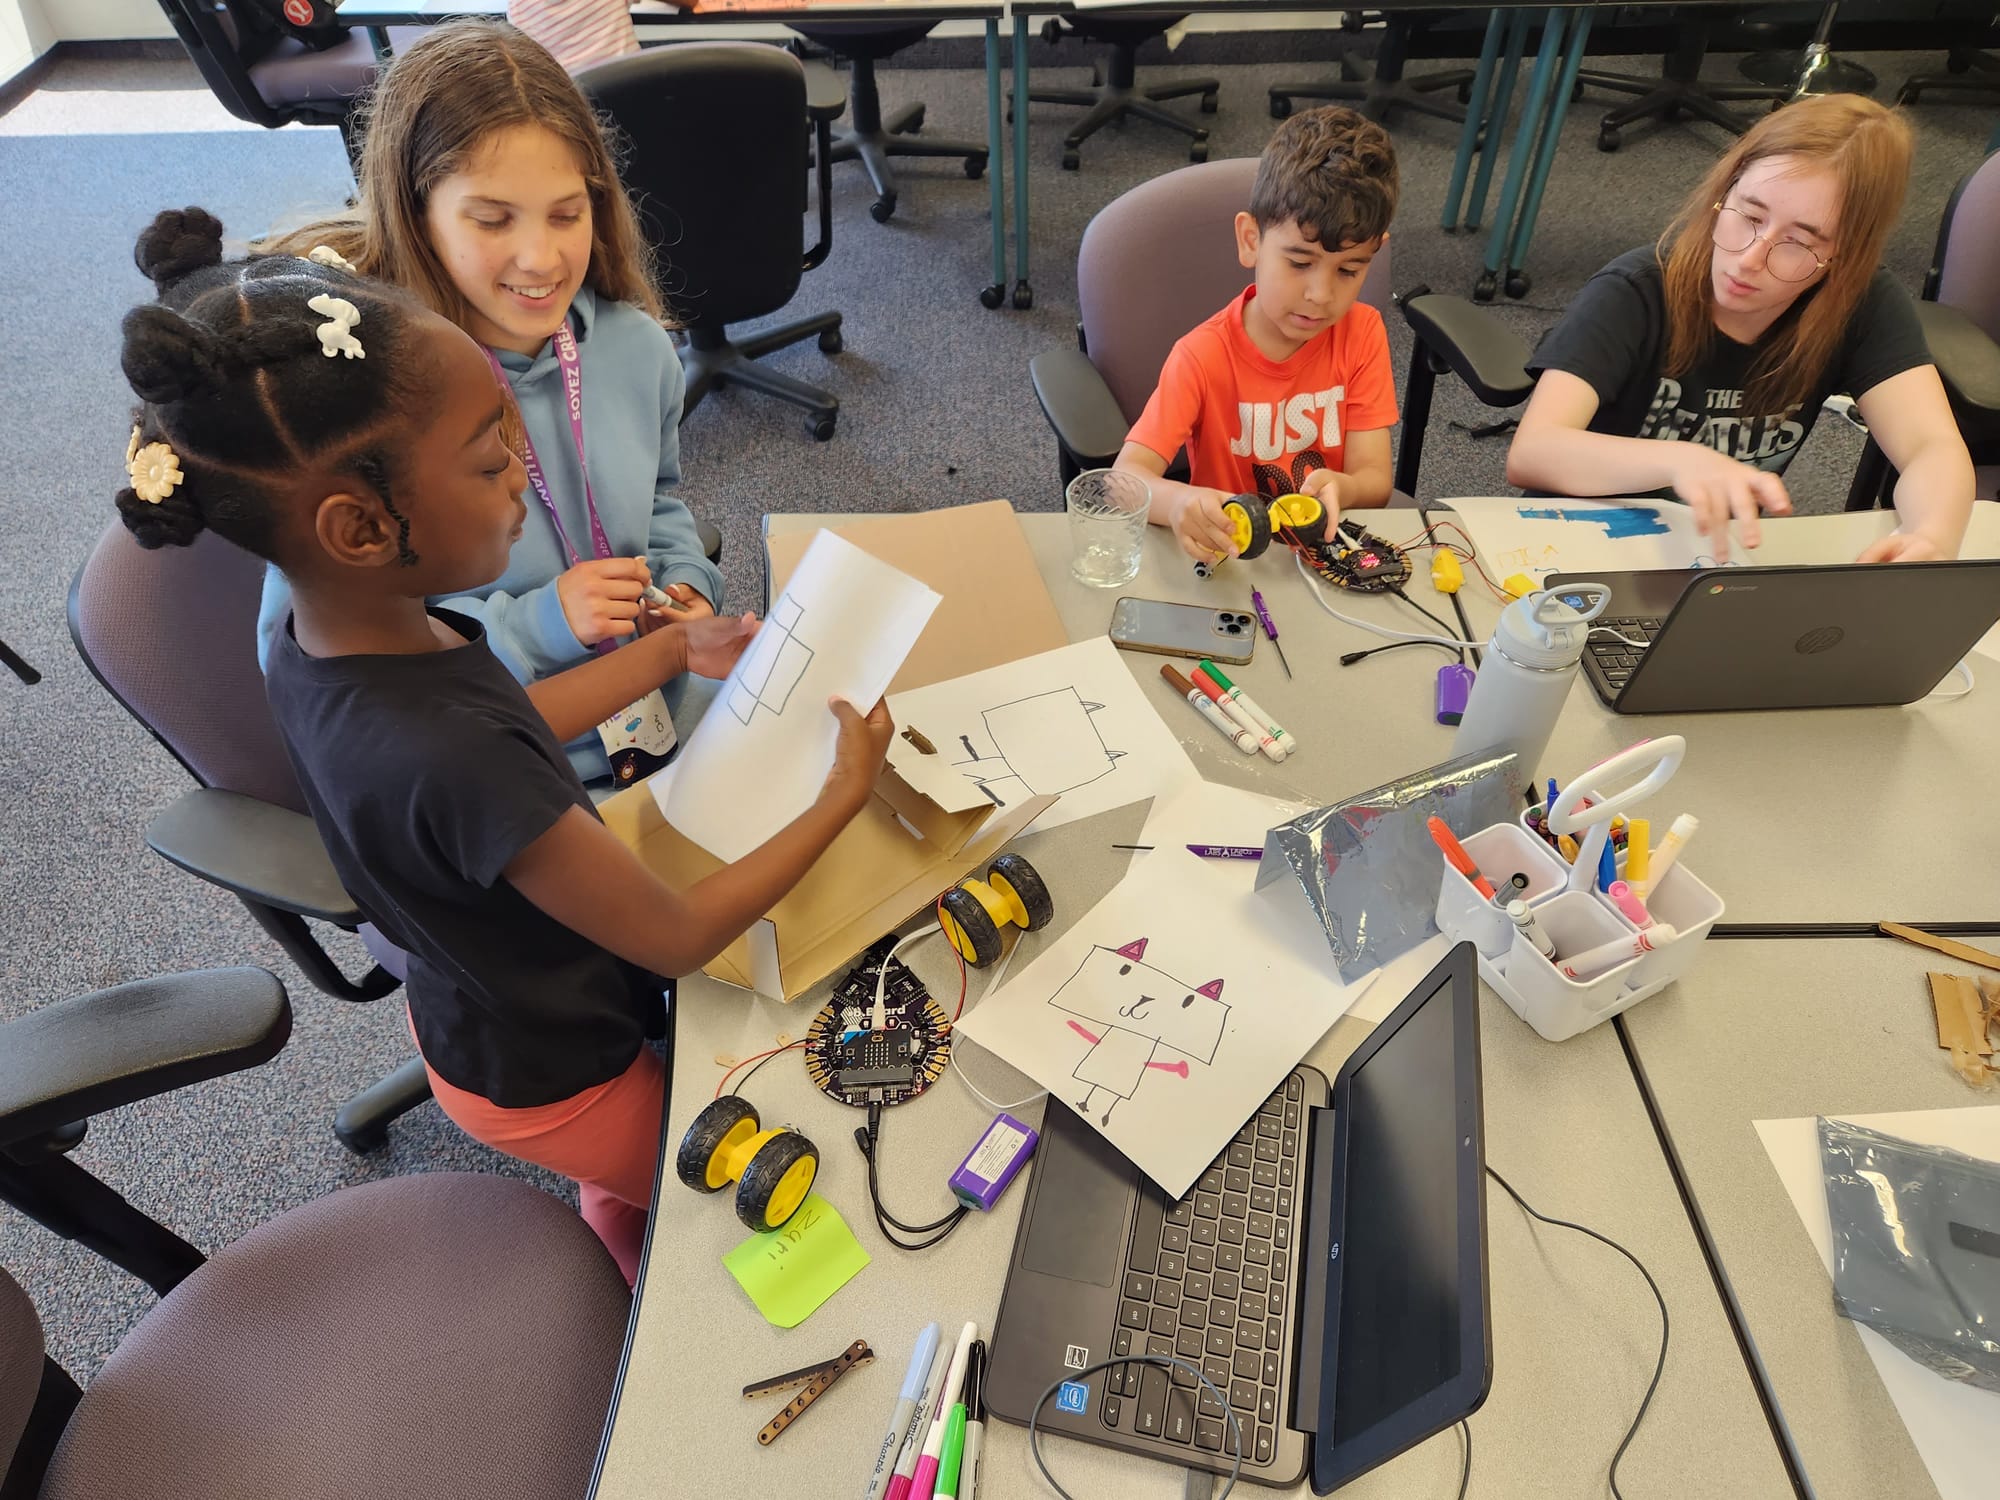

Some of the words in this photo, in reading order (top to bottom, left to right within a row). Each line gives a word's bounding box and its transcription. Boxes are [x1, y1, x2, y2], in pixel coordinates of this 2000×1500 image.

[566, 366, 581, 421] SOYEZ
[1705, 389, 1744, 409] THE
[1231, 385, 1345, 461] JUST
[1145, 1413, 1153, 1428] shift
[1176, 1417, 1184, 1435] enter
